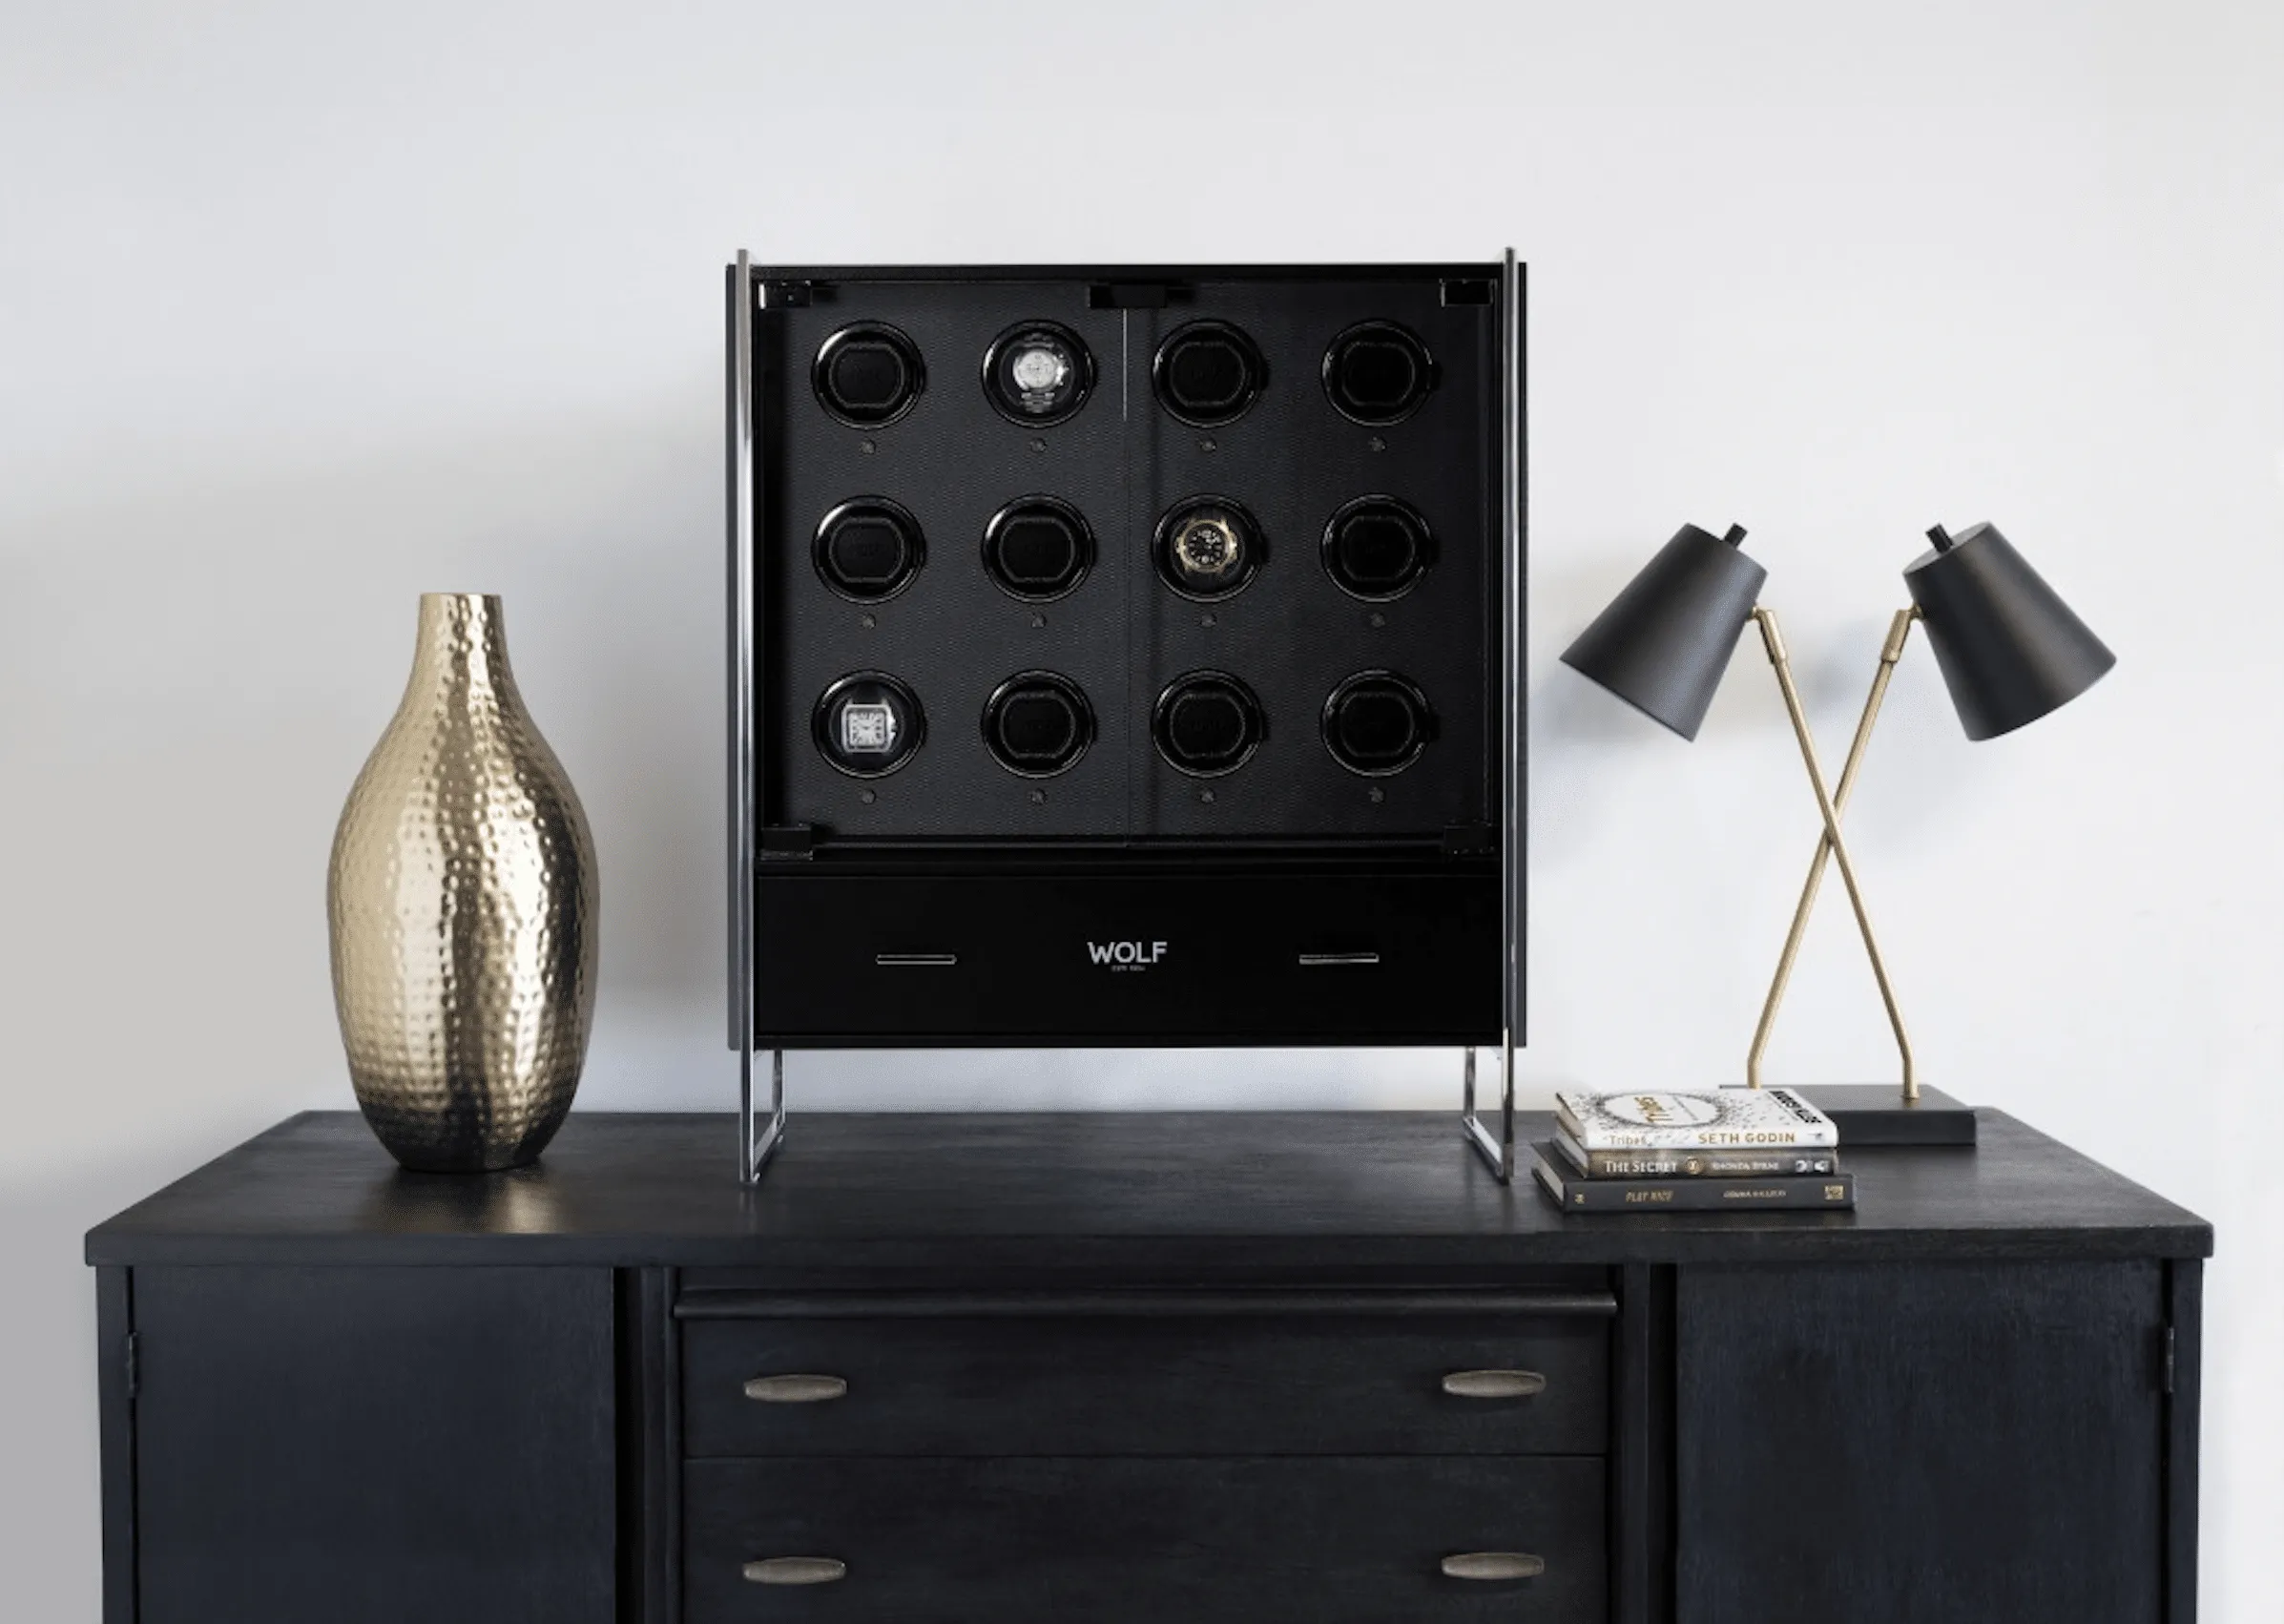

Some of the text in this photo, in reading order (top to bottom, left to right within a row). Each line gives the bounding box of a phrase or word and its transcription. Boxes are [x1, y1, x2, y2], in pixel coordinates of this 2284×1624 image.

[1087, 941, 1168, 964] WOLF
[1698, 1132, 1796, 1144] SETH GODIN
[1605, 1160, 1677, 1174] THE SECRET
